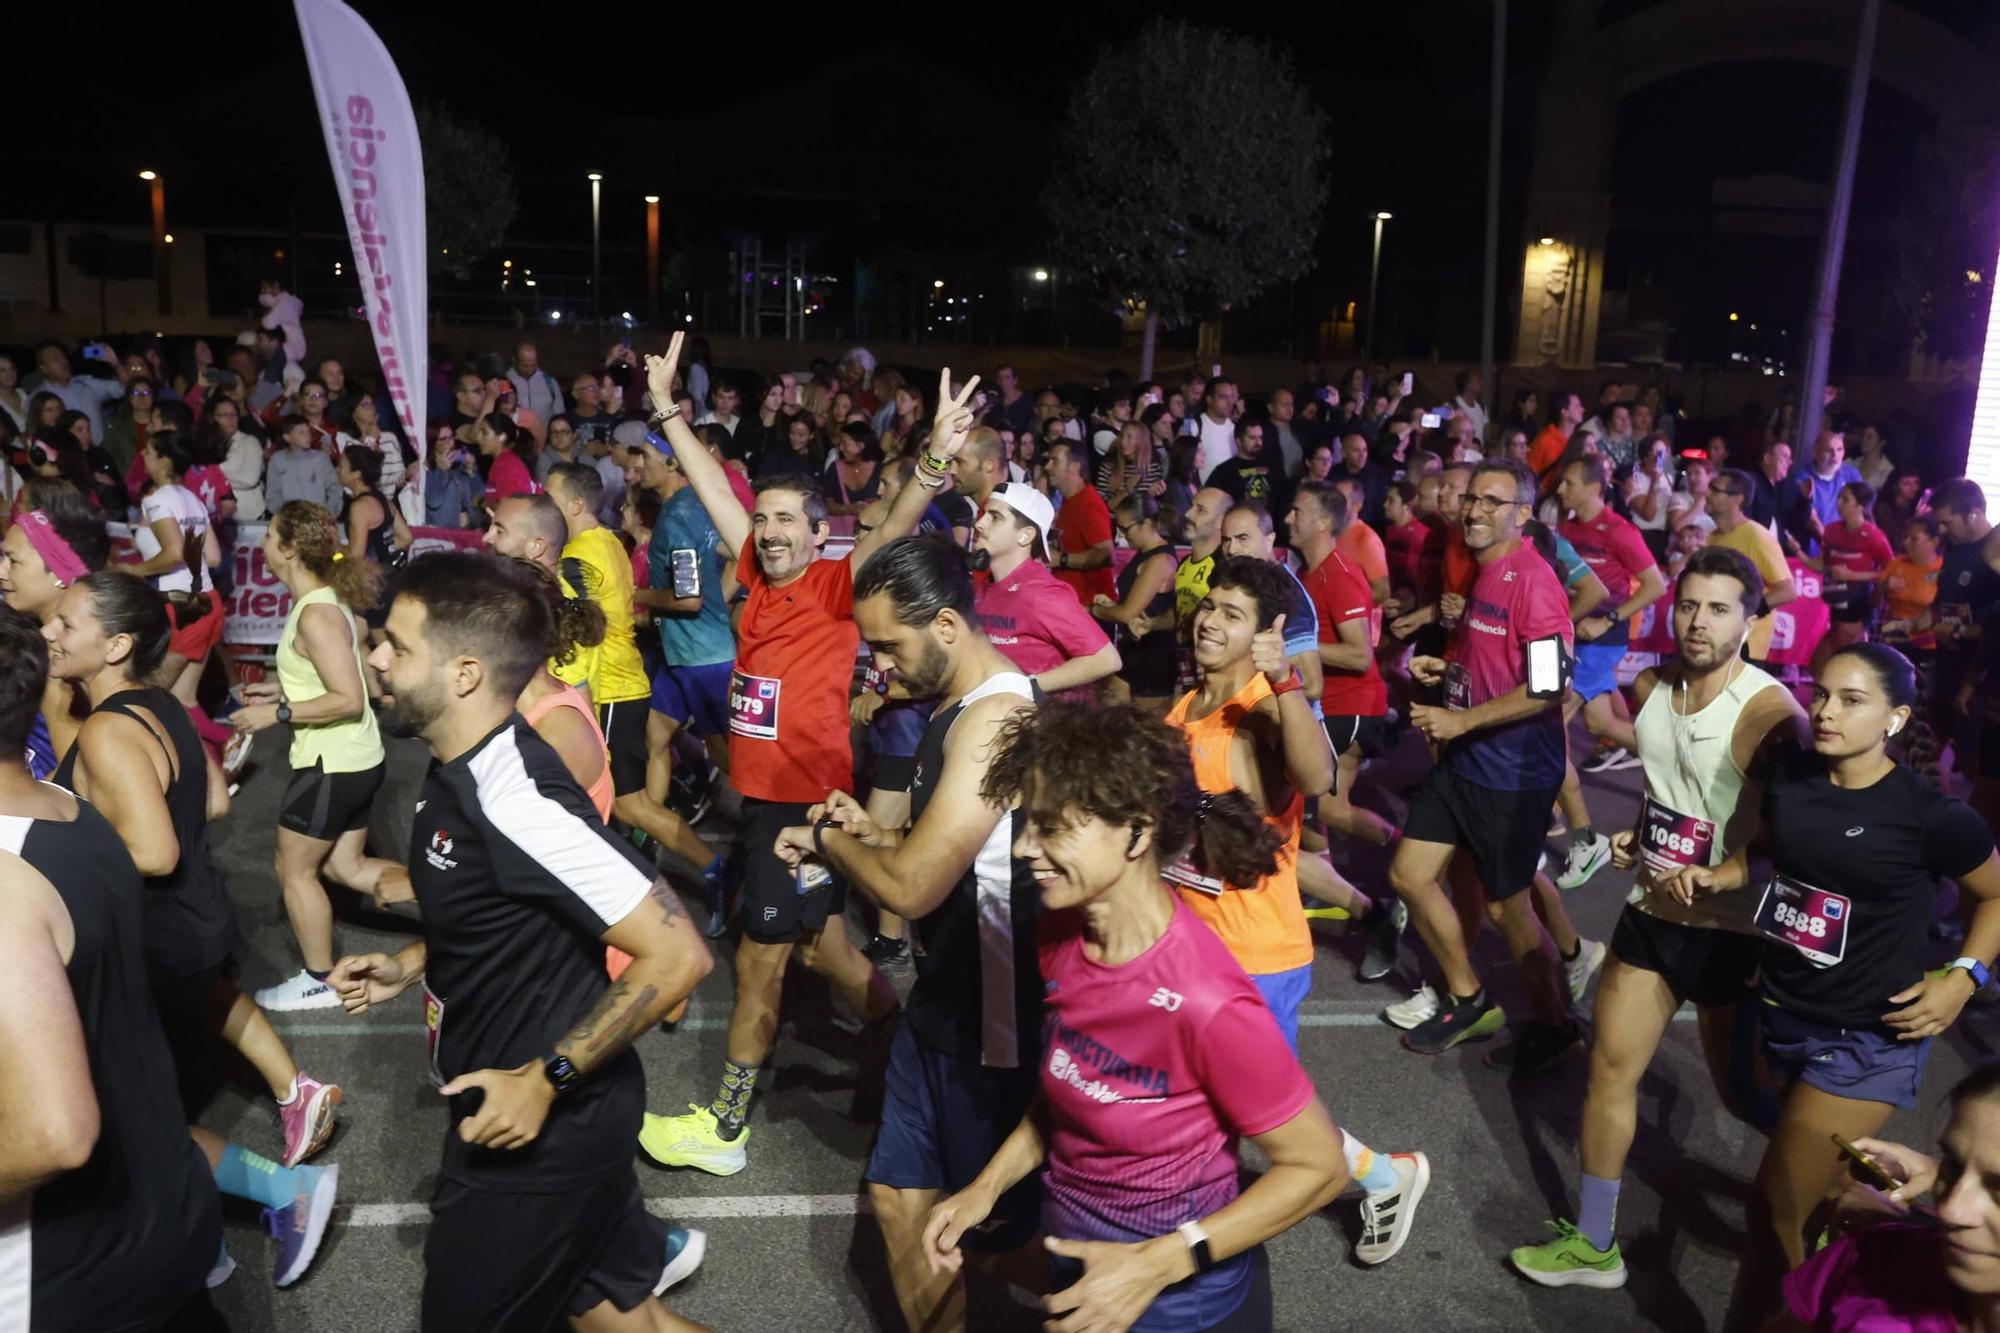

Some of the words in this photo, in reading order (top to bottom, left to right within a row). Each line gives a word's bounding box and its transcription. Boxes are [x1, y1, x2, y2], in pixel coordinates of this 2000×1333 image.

[1650, 824, 1695, 856] 1068
[1774, 902, 1827, 938] 8588
[302, 984, 329, 999] HOKA
